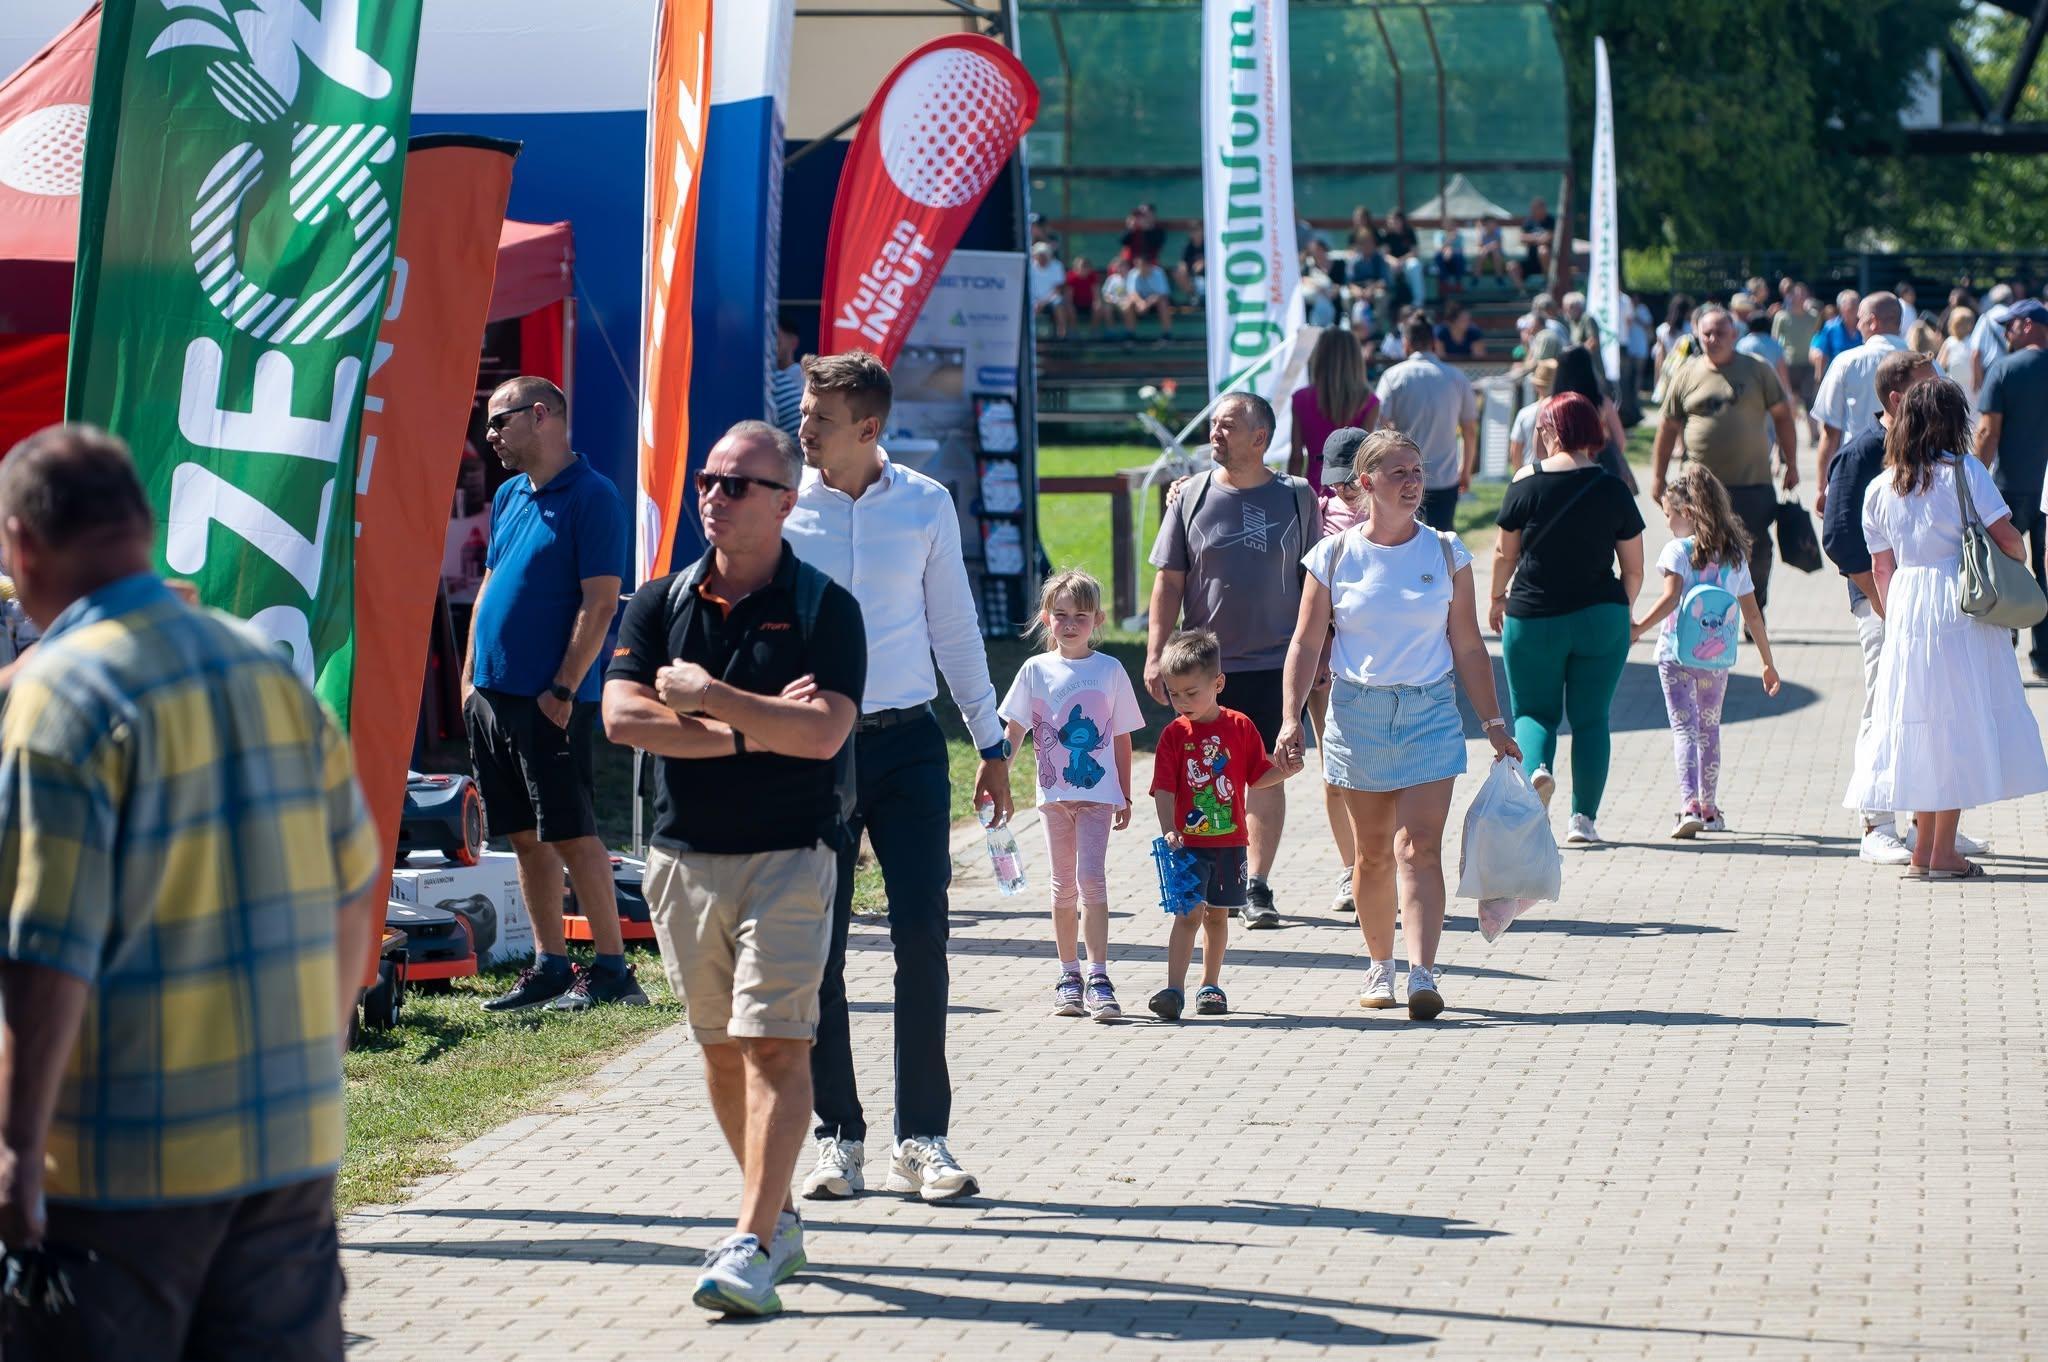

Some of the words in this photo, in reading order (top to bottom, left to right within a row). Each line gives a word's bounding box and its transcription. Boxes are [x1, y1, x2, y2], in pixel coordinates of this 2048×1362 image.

[833, 219, 917, 330] Vulcan
[861, 233, 935, 345] INPUT
[908, 1158, 921, 1172] N
